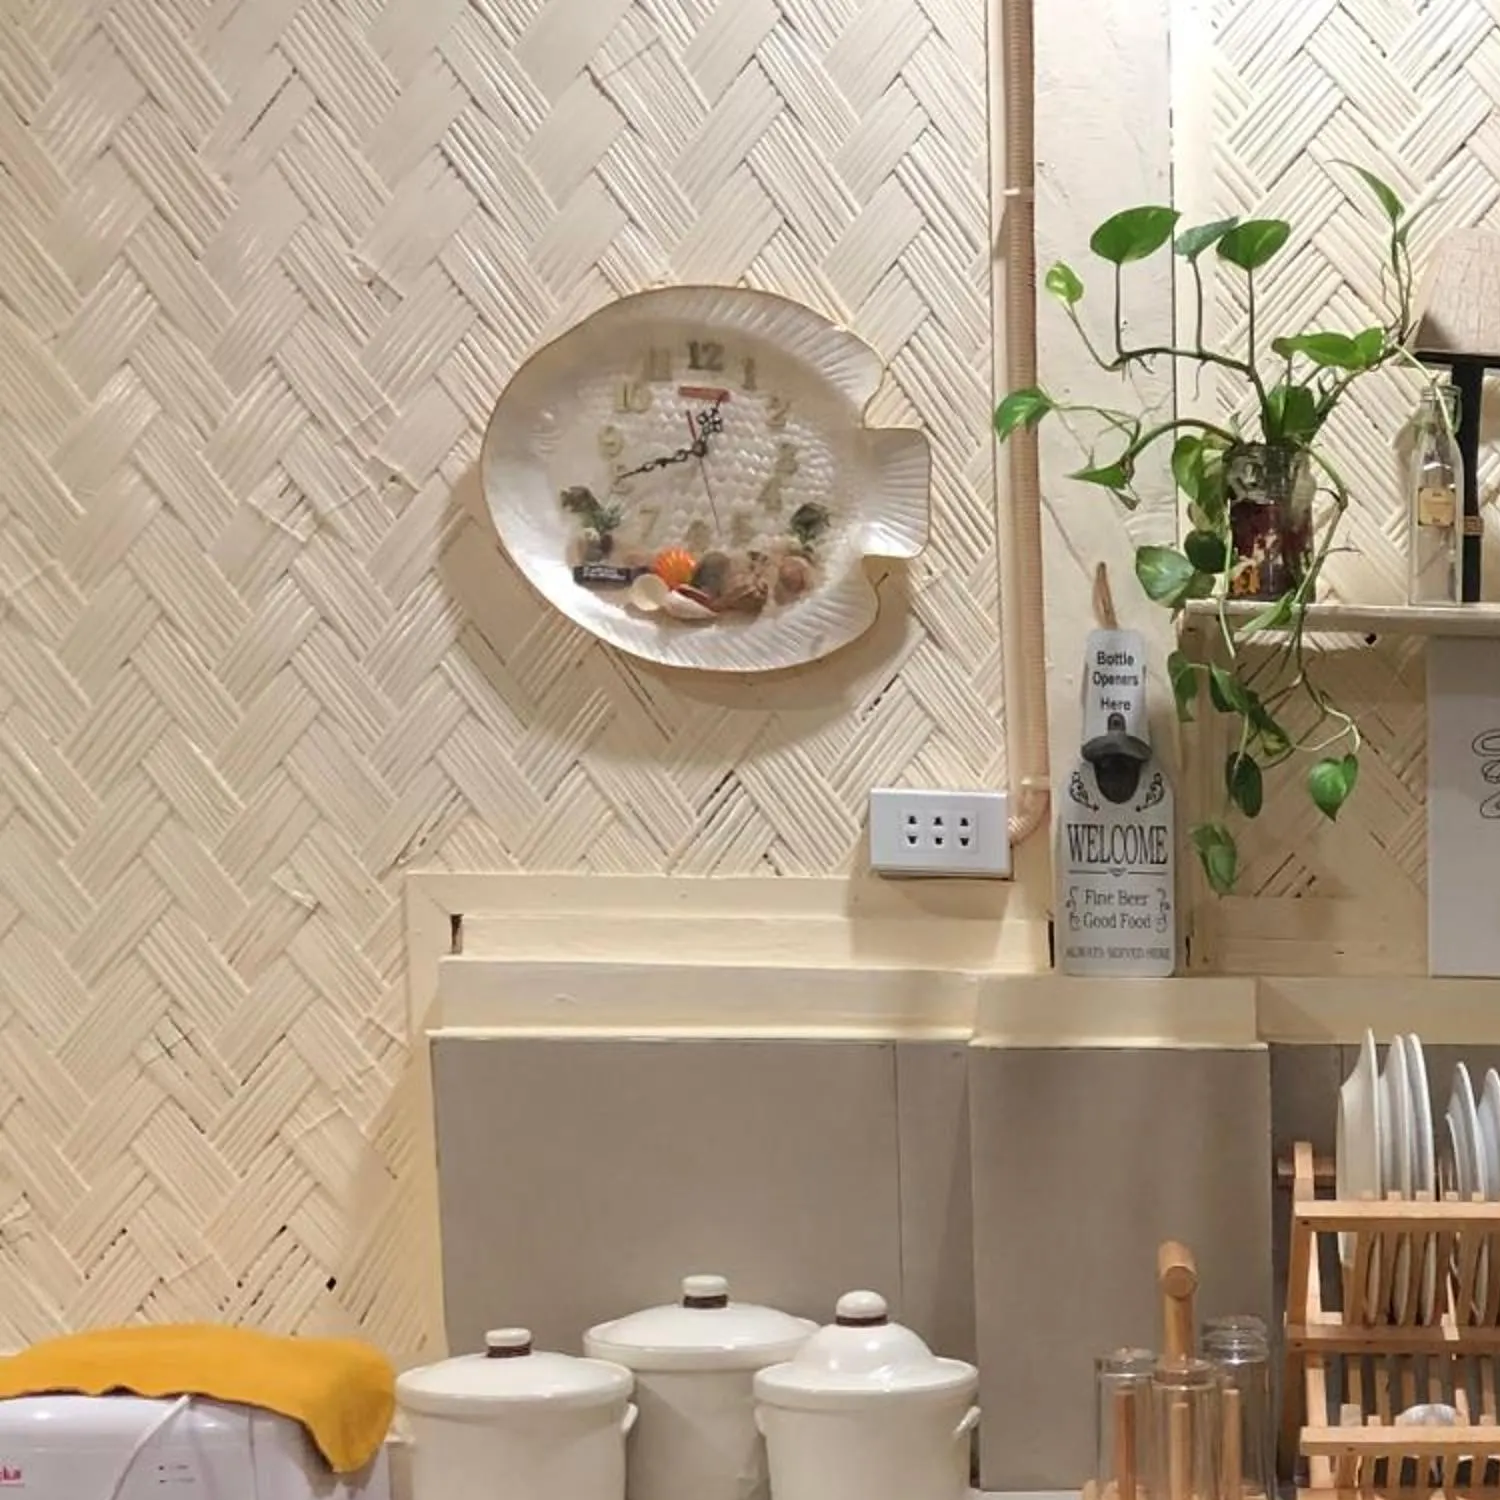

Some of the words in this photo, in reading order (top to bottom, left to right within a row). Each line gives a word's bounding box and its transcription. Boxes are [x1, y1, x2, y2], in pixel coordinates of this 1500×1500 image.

[687, 341, 723, 370] 12
[741, 357, 757, 391] 1
[766, 396, 790, 427] 2
[598, 425, 623, 459] 9
[1096, 651, 1135, 666] Bottle
[1092, 671, 1139, 687] Openers
[1101, 697, 1131, 710] Here
[1067, 823, 1169, 864] WELCOME
[1085, 888, 1115, 905] Fine
[1117, 888, 1150, 906] Beer
[1083, 911, 1117, 929] Good
[1119, 912, 1152, 929] Food
